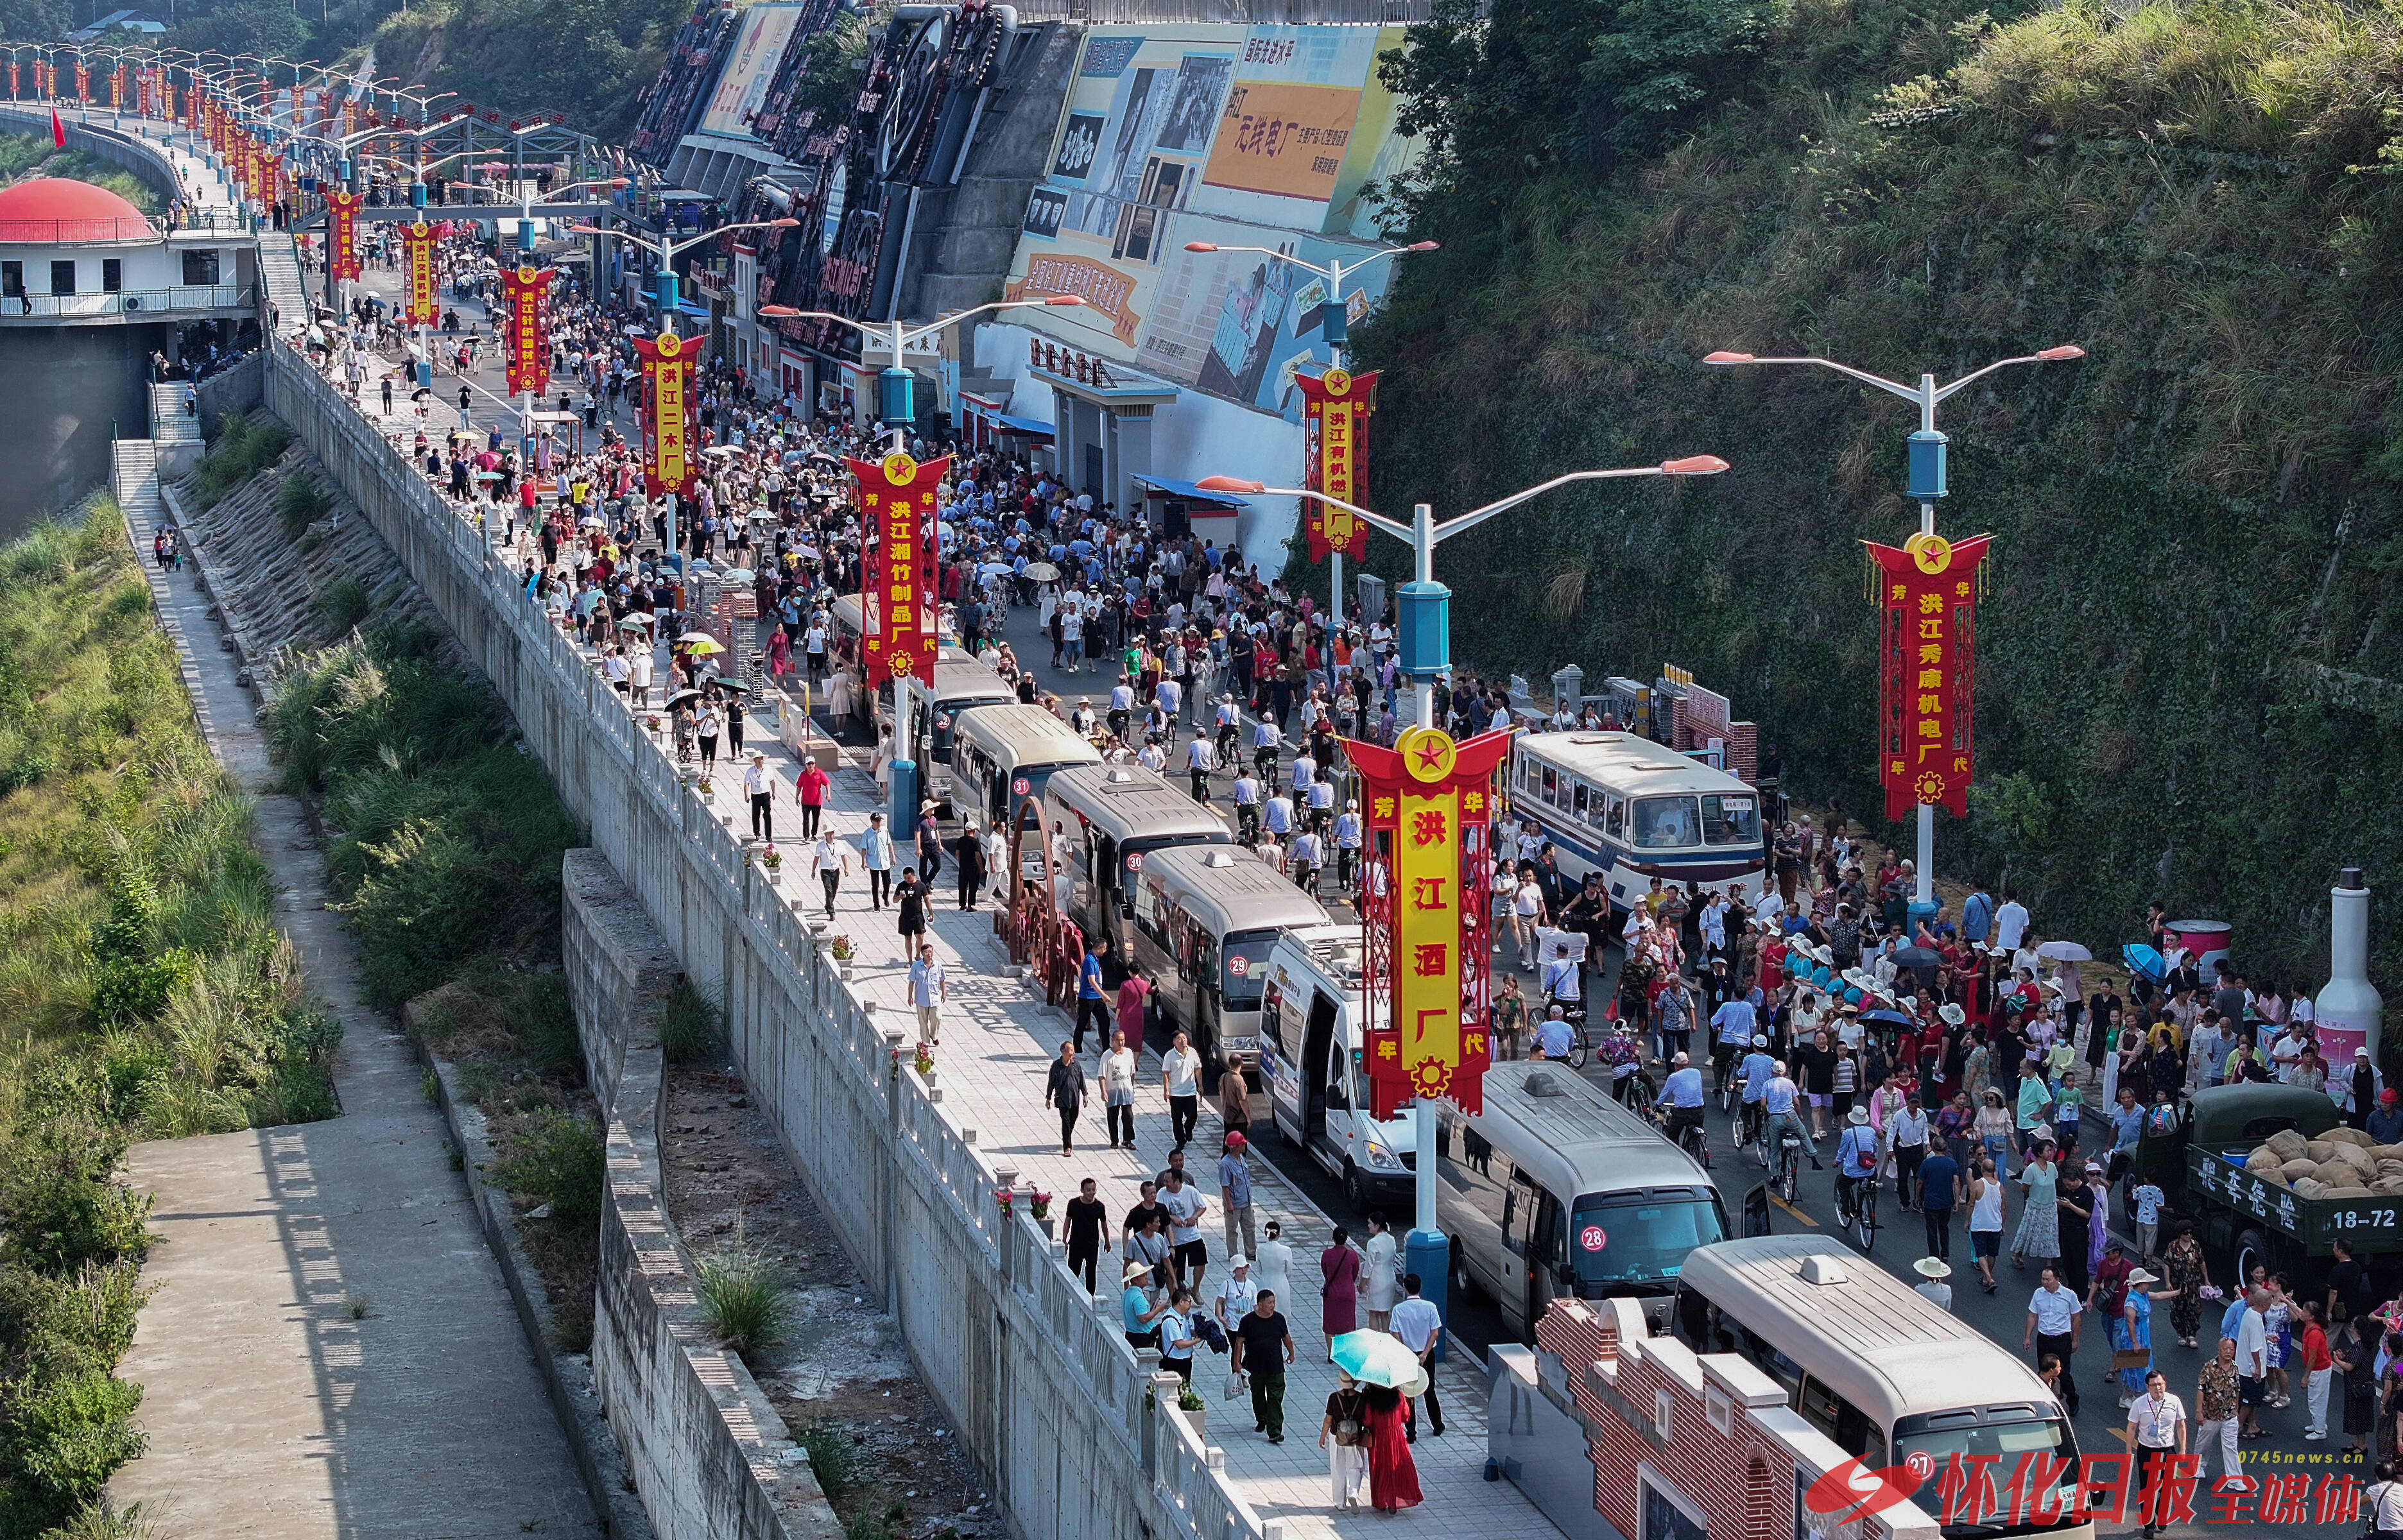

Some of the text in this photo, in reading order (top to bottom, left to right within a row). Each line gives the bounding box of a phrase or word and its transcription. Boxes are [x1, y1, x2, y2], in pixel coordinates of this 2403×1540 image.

[1244, 37, 1295, 65] 国际先进水平
[1224, 87, 1248, 118] 洪江
[1235, 116, 1299, 158] 无线电厂
[341, 211, 350, 266] 洪江模具厂
[416, 244, 427, 309] 洪江交通机械厂
[521, 292, 534, 372] 洪江针织器材厂
[871, 333, 940, 352] 洪机床
[645, 361, 693, 372] 芳 华
[1311, 402, 1364, 413] 芳 华
[662, 369, 678, 469] 洪江二木厂
[648, 466, 695, 475] 年 代
[866, 492, 933, 506] 芳 华
[1313, 521, 1365, 531] 年 代
[890, 501, 912, 644] 洪江湘竹制品厂
[1892, 582, 1970, 600] 芳 华
[868, 638, 936, 652] 年 代
[1918, 594, 1943, 765] 洪江秀康机电厂
[1891, 757, 1968, 775] 年 代
[1016, 782, 1026, 792] 31
[1374, 792, 1483, 819] 芳 华
[1130, 857, 1142, 867] 30
[1413, 810, 1447, 1043] 洪江酒厂
[1232, 960, 1245, 971] 29
[1378, 1034, 1485, 1061] 年 代
[2334, 1210, 2395, 1229] 18-72
[1585, 1231, 1602, 1247] 28
[1909, 1457, 1928, 1476] 27
